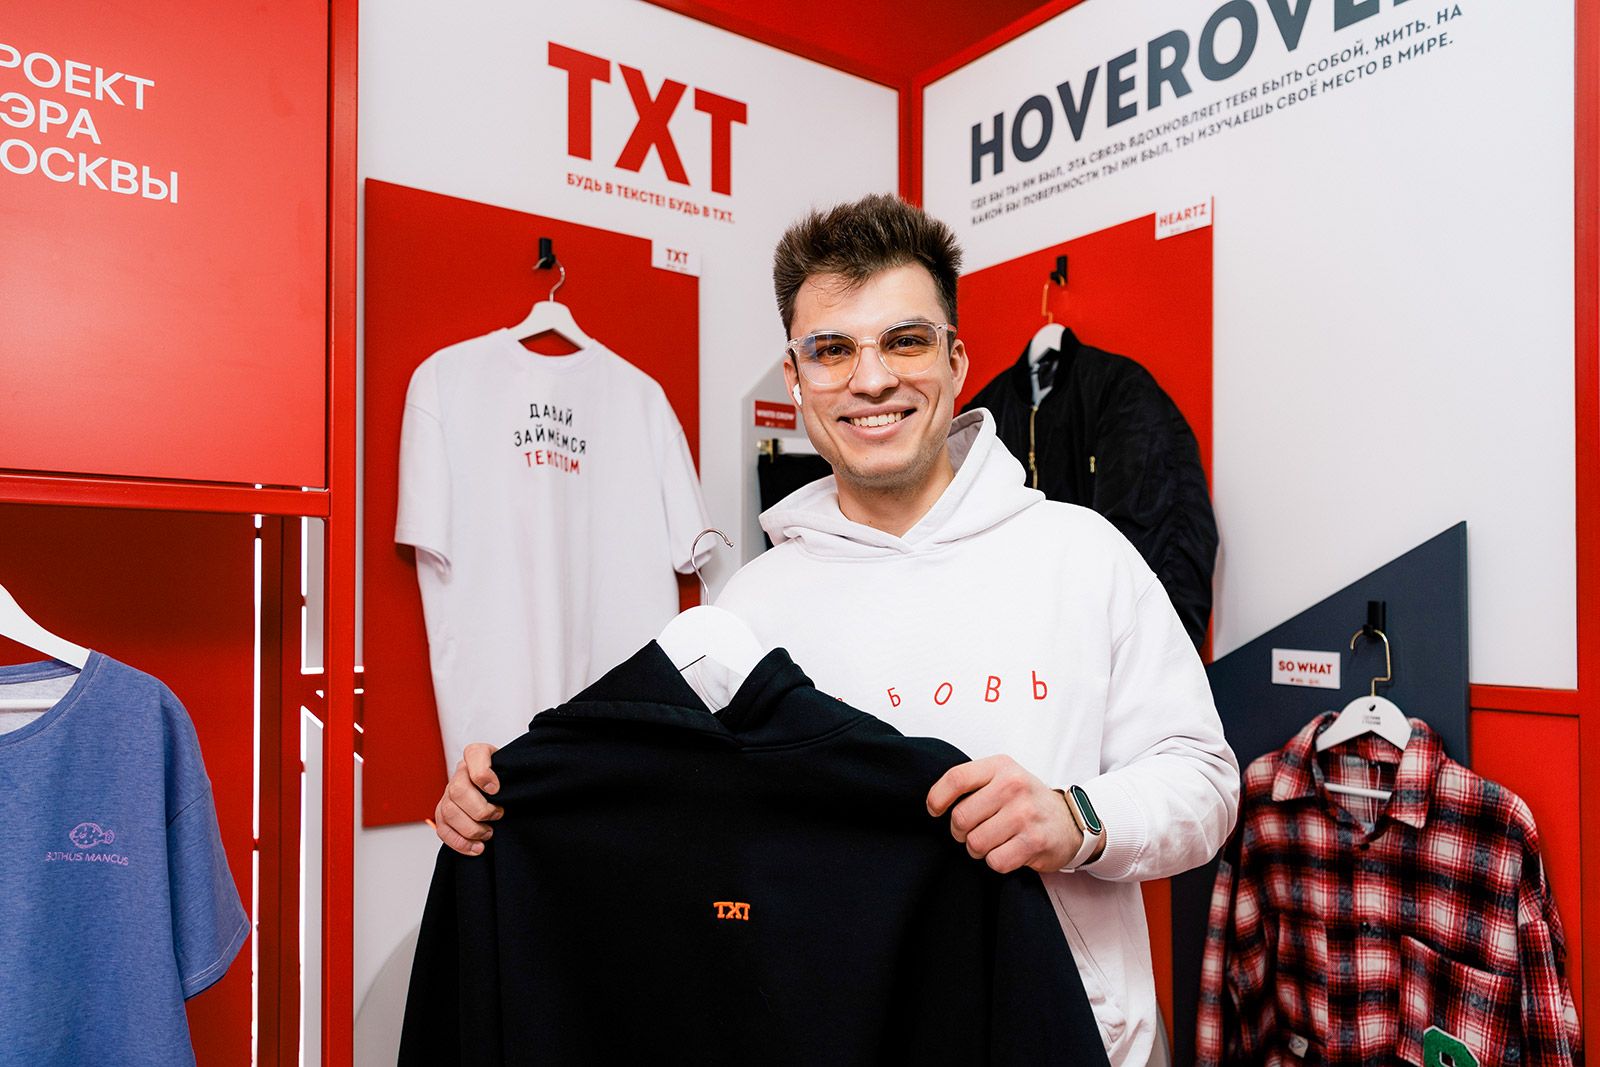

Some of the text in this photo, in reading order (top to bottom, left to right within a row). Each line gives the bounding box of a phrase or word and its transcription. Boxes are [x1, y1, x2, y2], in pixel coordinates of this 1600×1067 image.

[971, 0, 1412, 184] HOVEROV
[1068, 159, 1086, 172] ЭТА
[1090, 144, 1126, 163] СВЯЗЬ
[1130, 101, 1222, 150] ВДОХНОВЛЯЕТ
[1226, 87, 1258, 110] ТЕБЯ
[1262, 70, 1302, 95] БЫТЬ
[1375, 20, 1431, 50] ЖИТЬ.
[1437, 4, 1463, 25] НА
[548, 41, 747, 196] TXT
[1102, 163, 1119, 177] ТЫ
[1176, 132, 1194, 149] ТЫ
[1198, 103, 1273, 140] ИЗУЧАЕШЬ
[1277, 80, 1317, 110] СВОЁ
[1322, 61, 1377, 93] МЕСТО
[1382, 55, 1392, 70] В
[1398, 32, 1454, 64] МИРЕ.
[0, 139, 178, 204] ОСКВЫ
[567, 173, 602, 191] БУДЬ
[605, 182, 613, 194] В
[617, 184, 666, 207] ТЕКСТЕ!
[669, 198, 700, 216] БУДЬ
[702, 205, 710, 217] В
[1159, 203, 1206, 227] HEARTZ
[666, 248, 688, 265] TXT
[530, 403, 573, 427] ДАВАЙ
[514, 424, 587, 454] ЗАЙМЁМСЯ
[524, 449, 580, 474] ТЕКСТОМ
[1278, 660, 1333, 675] SO WHAT
[836, 671, 1048, 708] БОВЬ
[85, 853, 129, 866] MANCUS
[713, 901, 750, 920] TXT
